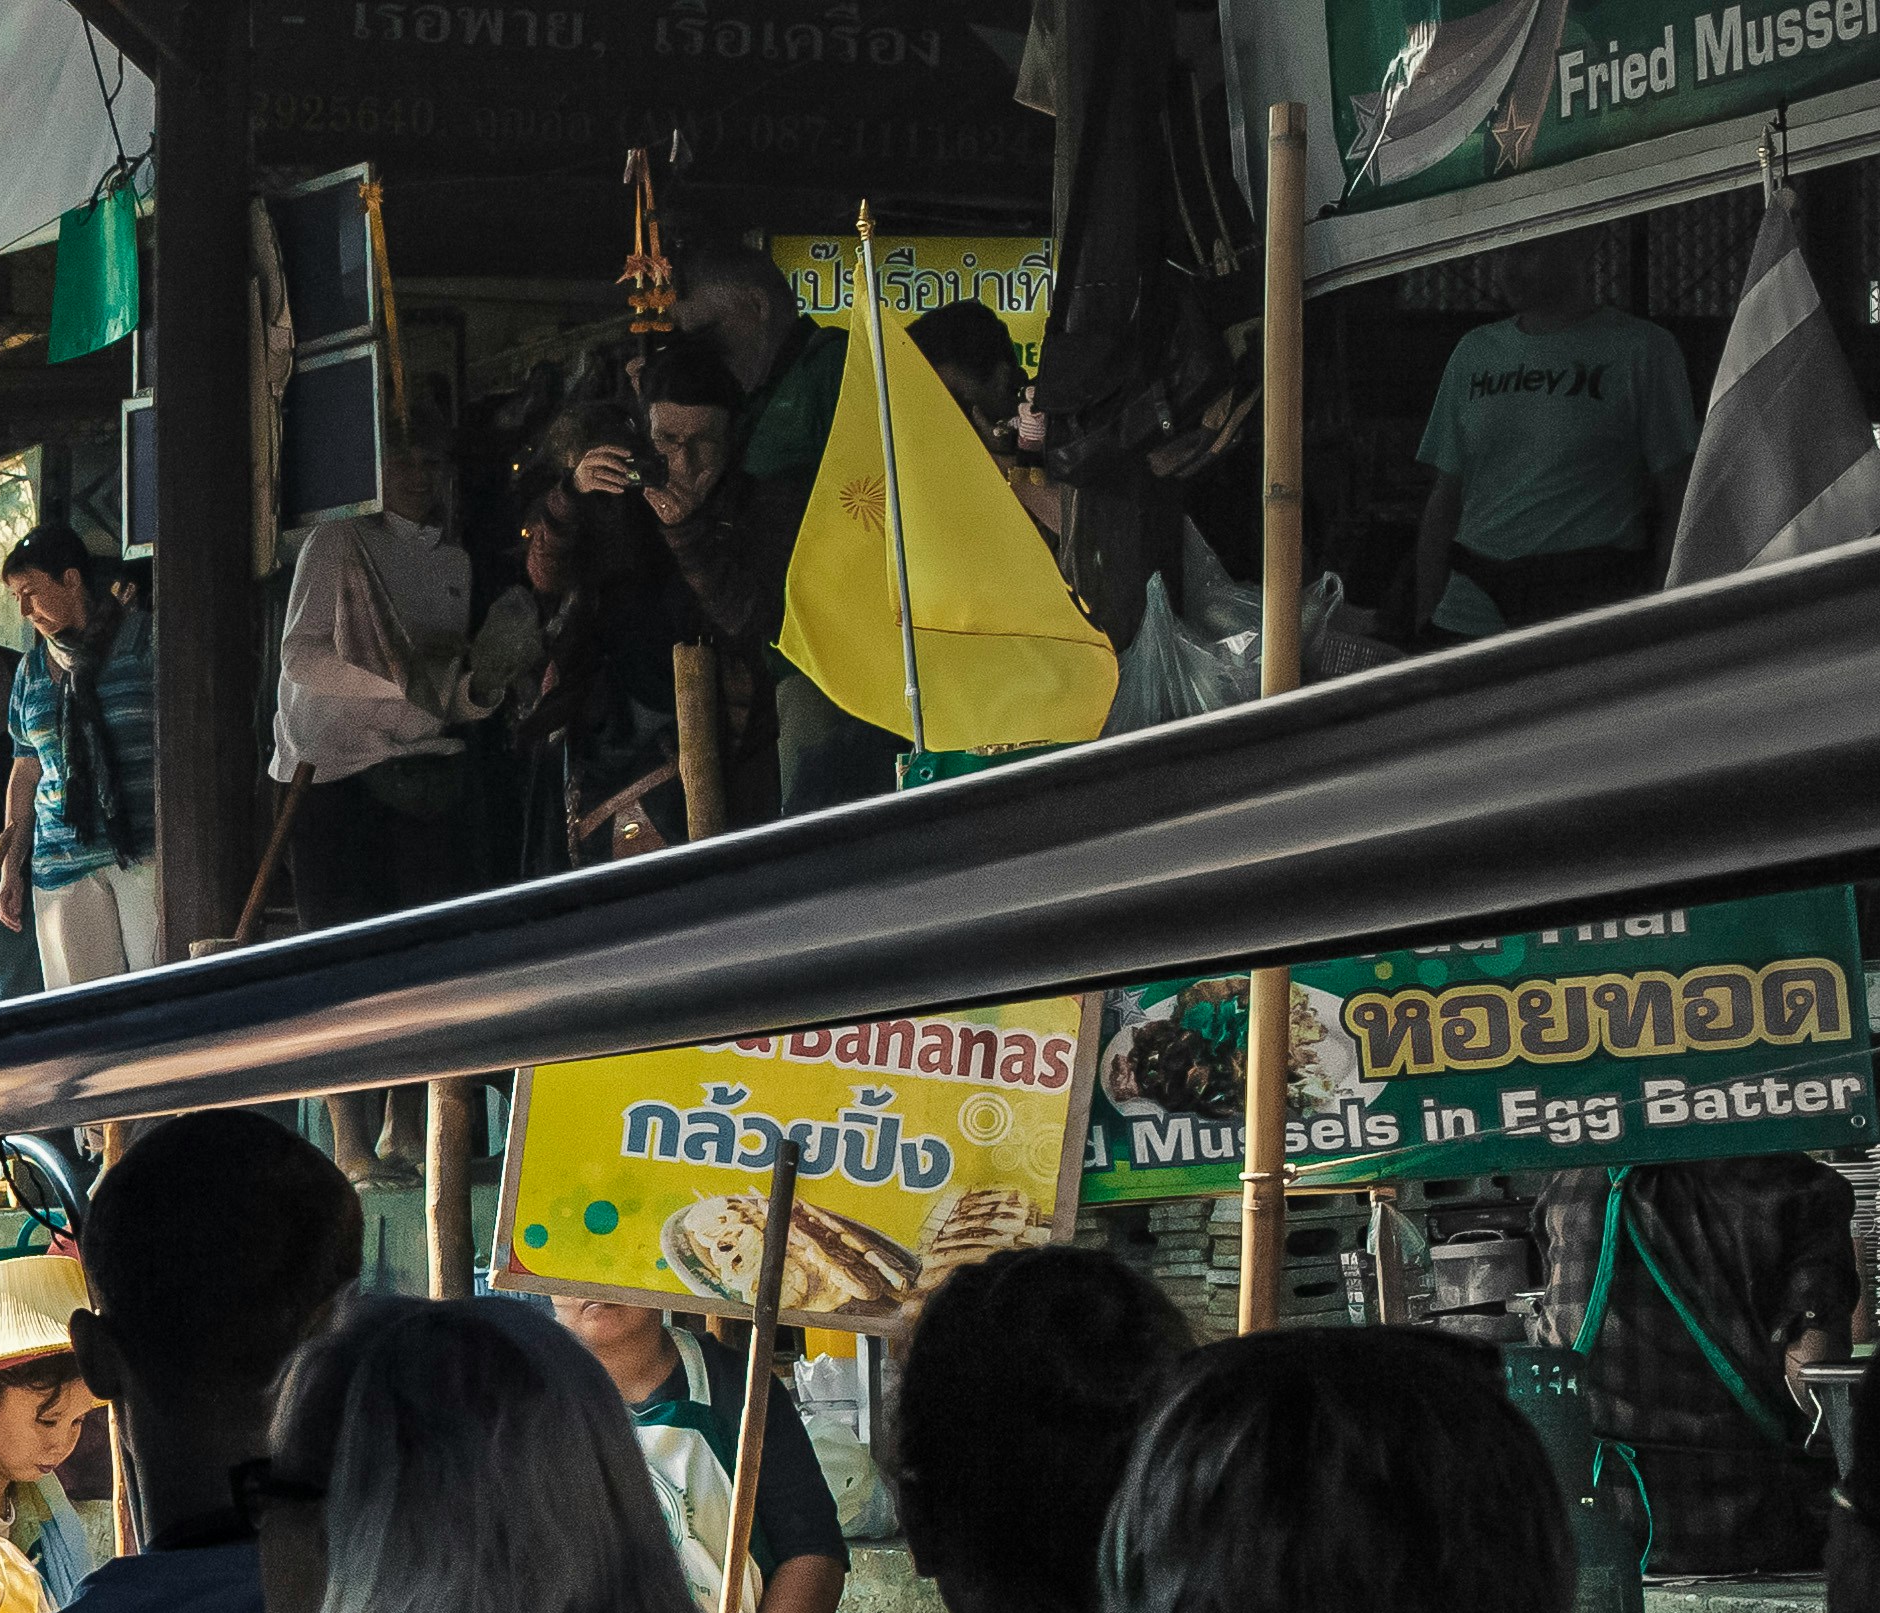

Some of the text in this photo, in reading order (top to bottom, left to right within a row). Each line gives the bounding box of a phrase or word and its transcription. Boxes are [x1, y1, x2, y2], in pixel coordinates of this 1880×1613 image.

[1558, 0, 1880, 118] Fried Mussel
[1469, 363, 1568, 402] Hurley
[1350, 962, 1846, 1072] หอยทอด
[626, 1086, 952, 1190] กล้วยปิ้ง
[1423, 1099, 1477, 1142] in
[1501, 1090, 1621, 1143] Egg
[1645, 1076, 1863, 1126] Batter
